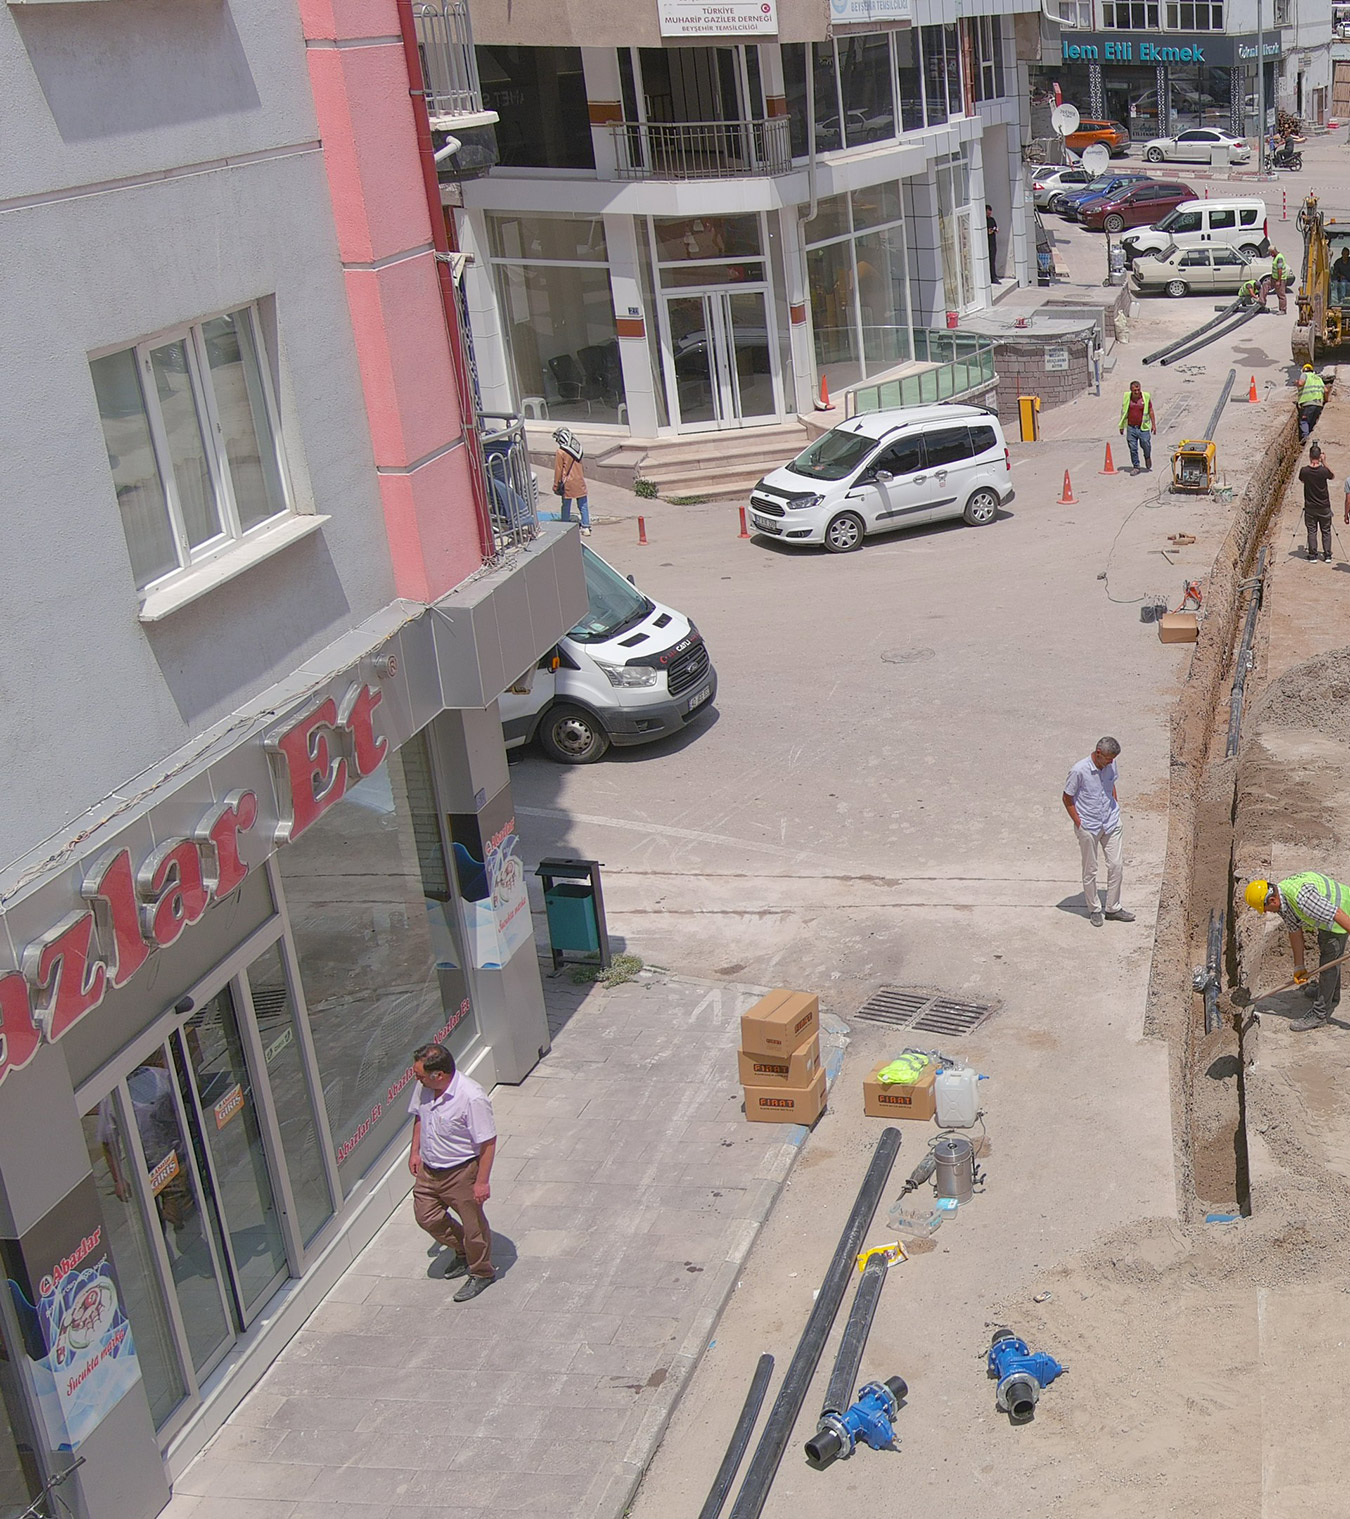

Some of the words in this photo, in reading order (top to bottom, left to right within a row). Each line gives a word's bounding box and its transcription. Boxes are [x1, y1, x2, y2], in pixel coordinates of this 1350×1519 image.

[664, 16, 703, 24] MUHARİP
[703, 15, 737, 23] GAZİLER
[737, 14, 773, 23] DERNEĞİ
[702, 7, 735, 15] TÜRKİYE
[681, 24, 714, 32] BEYŞEHİR
[715, 23, 758, 31] TEMSİLCİLİĞİ
[1062, 41, 1098, 60] lem
[1104, 41, 1132, 61] Etli
[1139, 42, 1206, 62] Ekmek
[263, 680, 390, 844] Et
[459, 998, 470, 1017] Et
[754, 1064, 788, 1073] FIRAT
[386, 1066, 416, 1106] Abazla
[218, 1094, 241, 1120] GİRİŞ
[760, 1098, 794, 1107] FIRAT
[878, 1096, 912, 1105] FIRAT
[336, 1117, 371, 1167] Abazlar
[371, 1103, 383, 1125] Et
[52, 1227, 101, 1286] Abazlar
